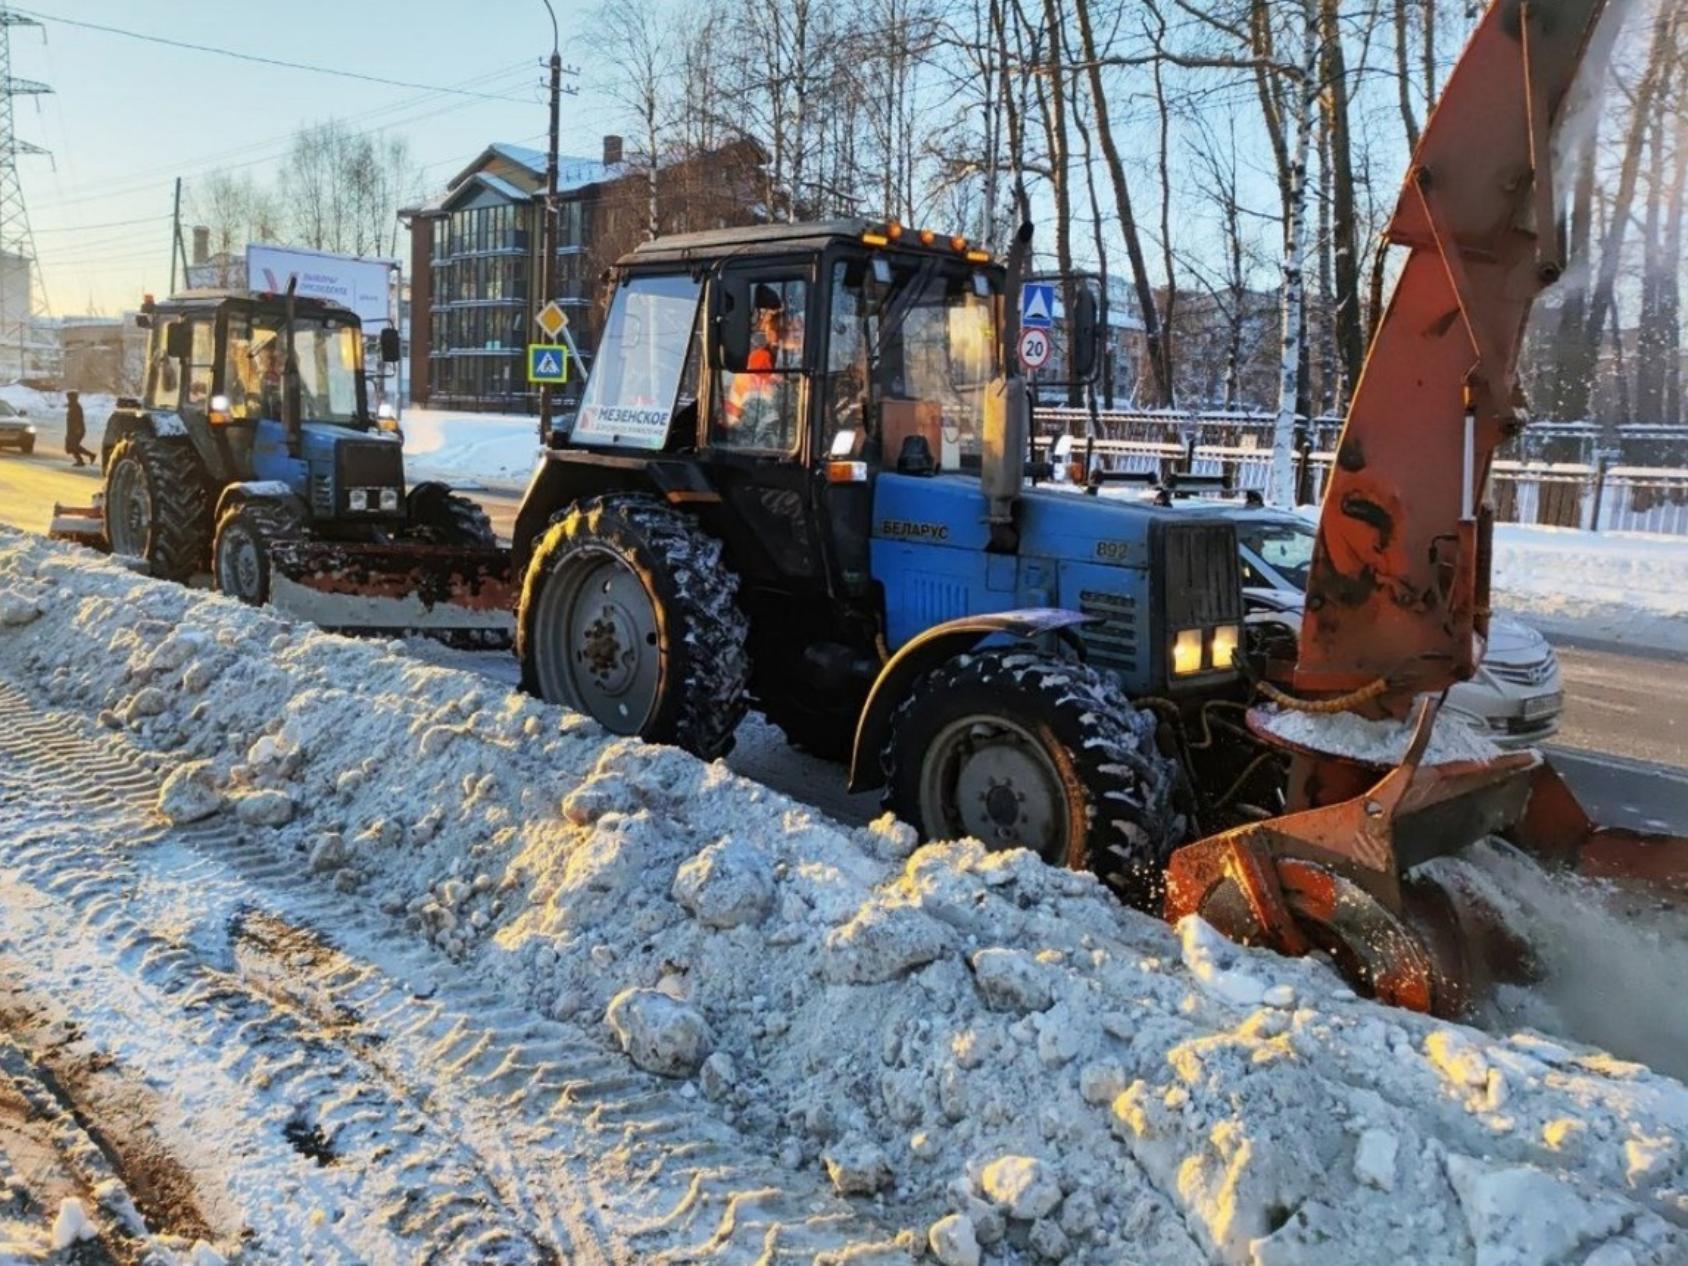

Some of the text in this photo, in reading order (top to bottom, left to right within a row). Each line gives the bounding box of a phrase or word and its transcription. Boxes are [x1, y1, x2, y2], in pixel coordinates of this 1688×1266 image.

[1026, 340, 1044, 357] 20
[598, 407, 669, 426] МЕЗЕНСКОЕ
[882, 520, 949, 540] БЕЛАРУС
[1096, 541, 1129, 560] 892
